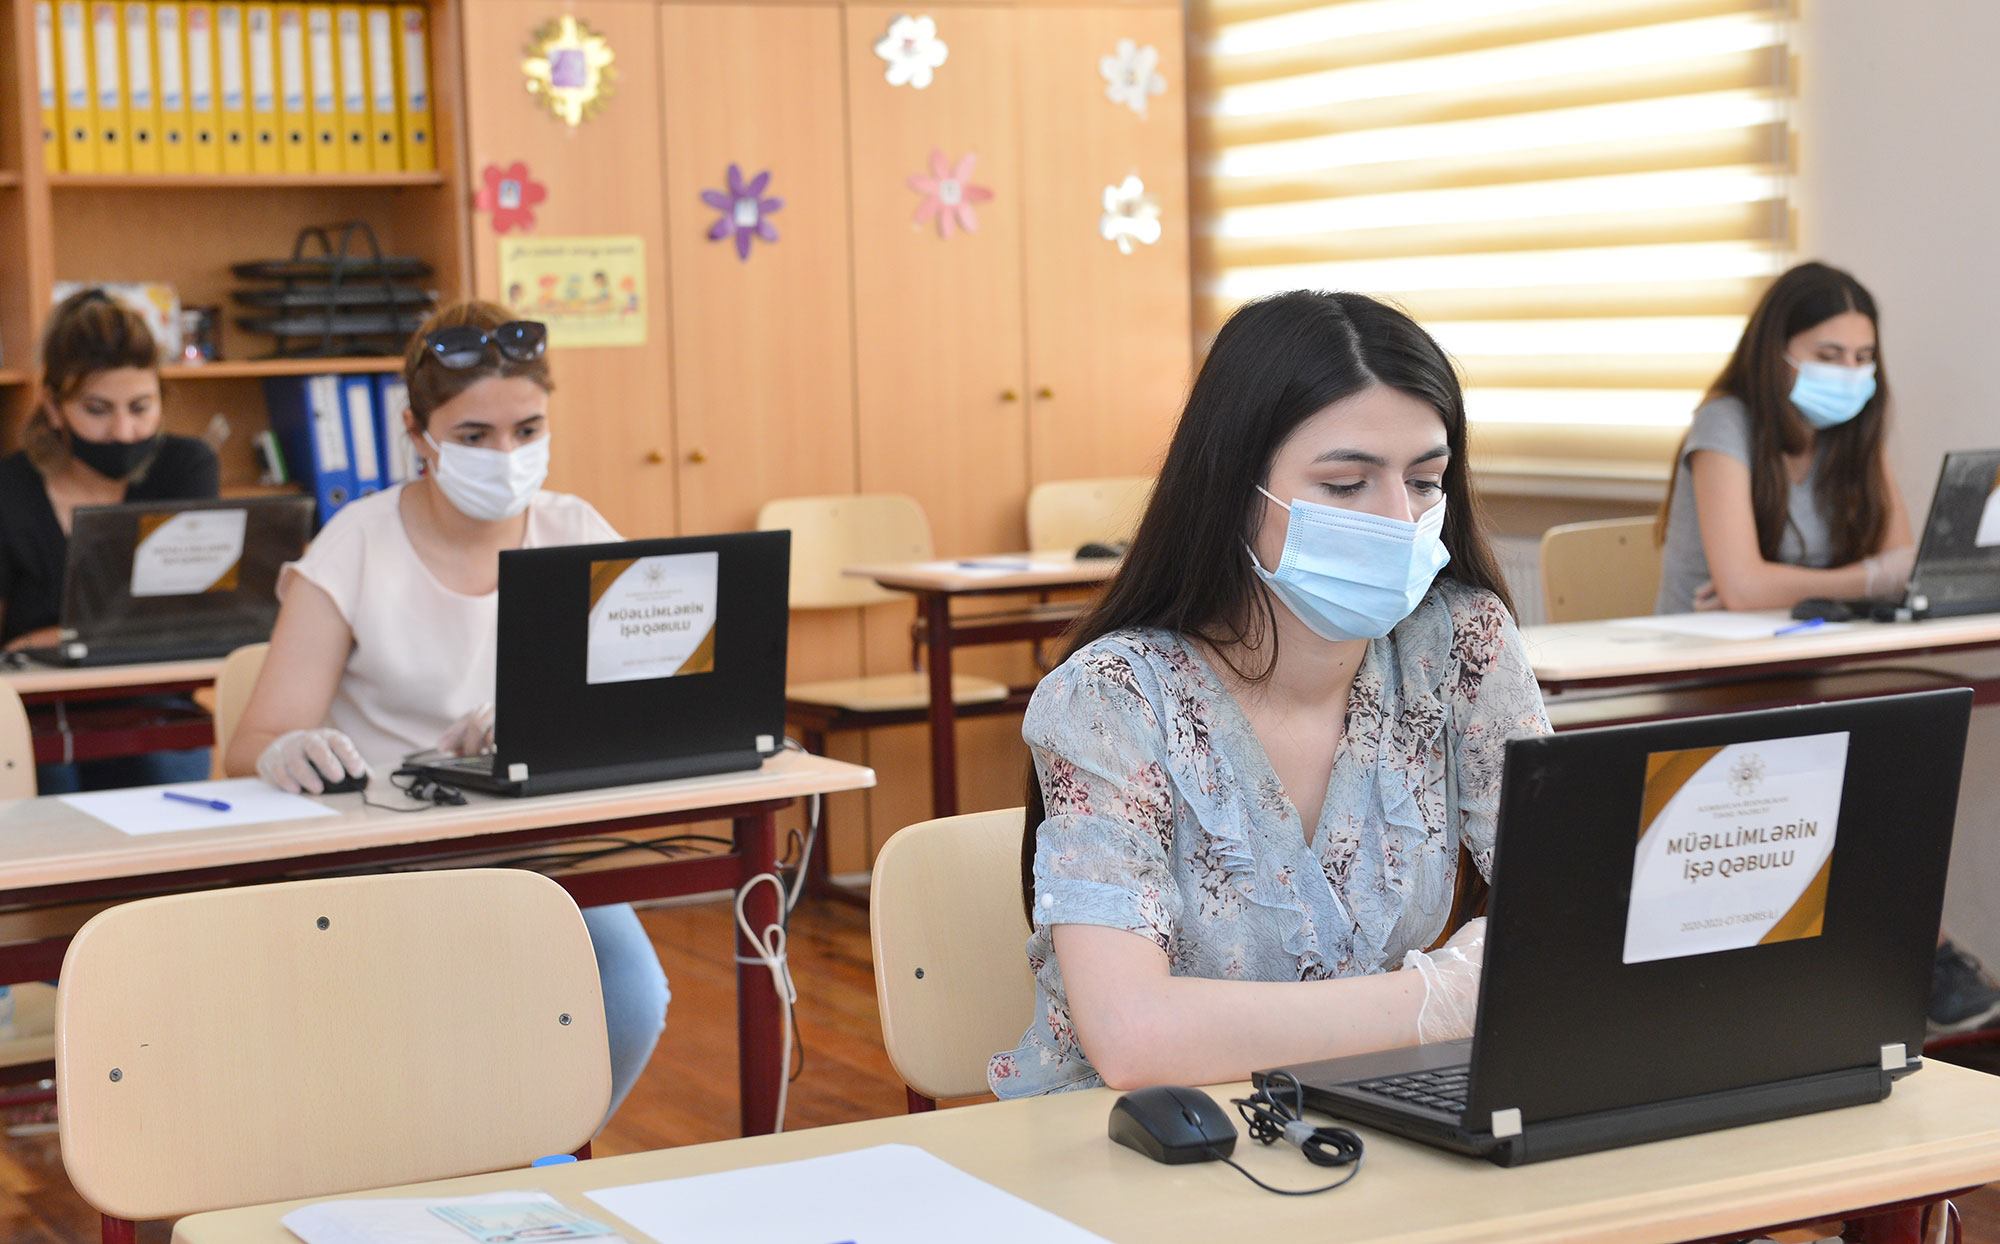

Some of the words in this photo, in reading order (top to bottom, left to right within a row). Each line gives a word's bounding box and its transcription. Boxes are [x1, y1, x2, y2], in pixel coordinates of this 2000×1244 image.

[1666, 818, 1818, 855] MÜƏLLİMLƏRİN
[1683, 859, 1714, 884] İŞƏ
[1718, 850, 1795, 878] QƏBULU
